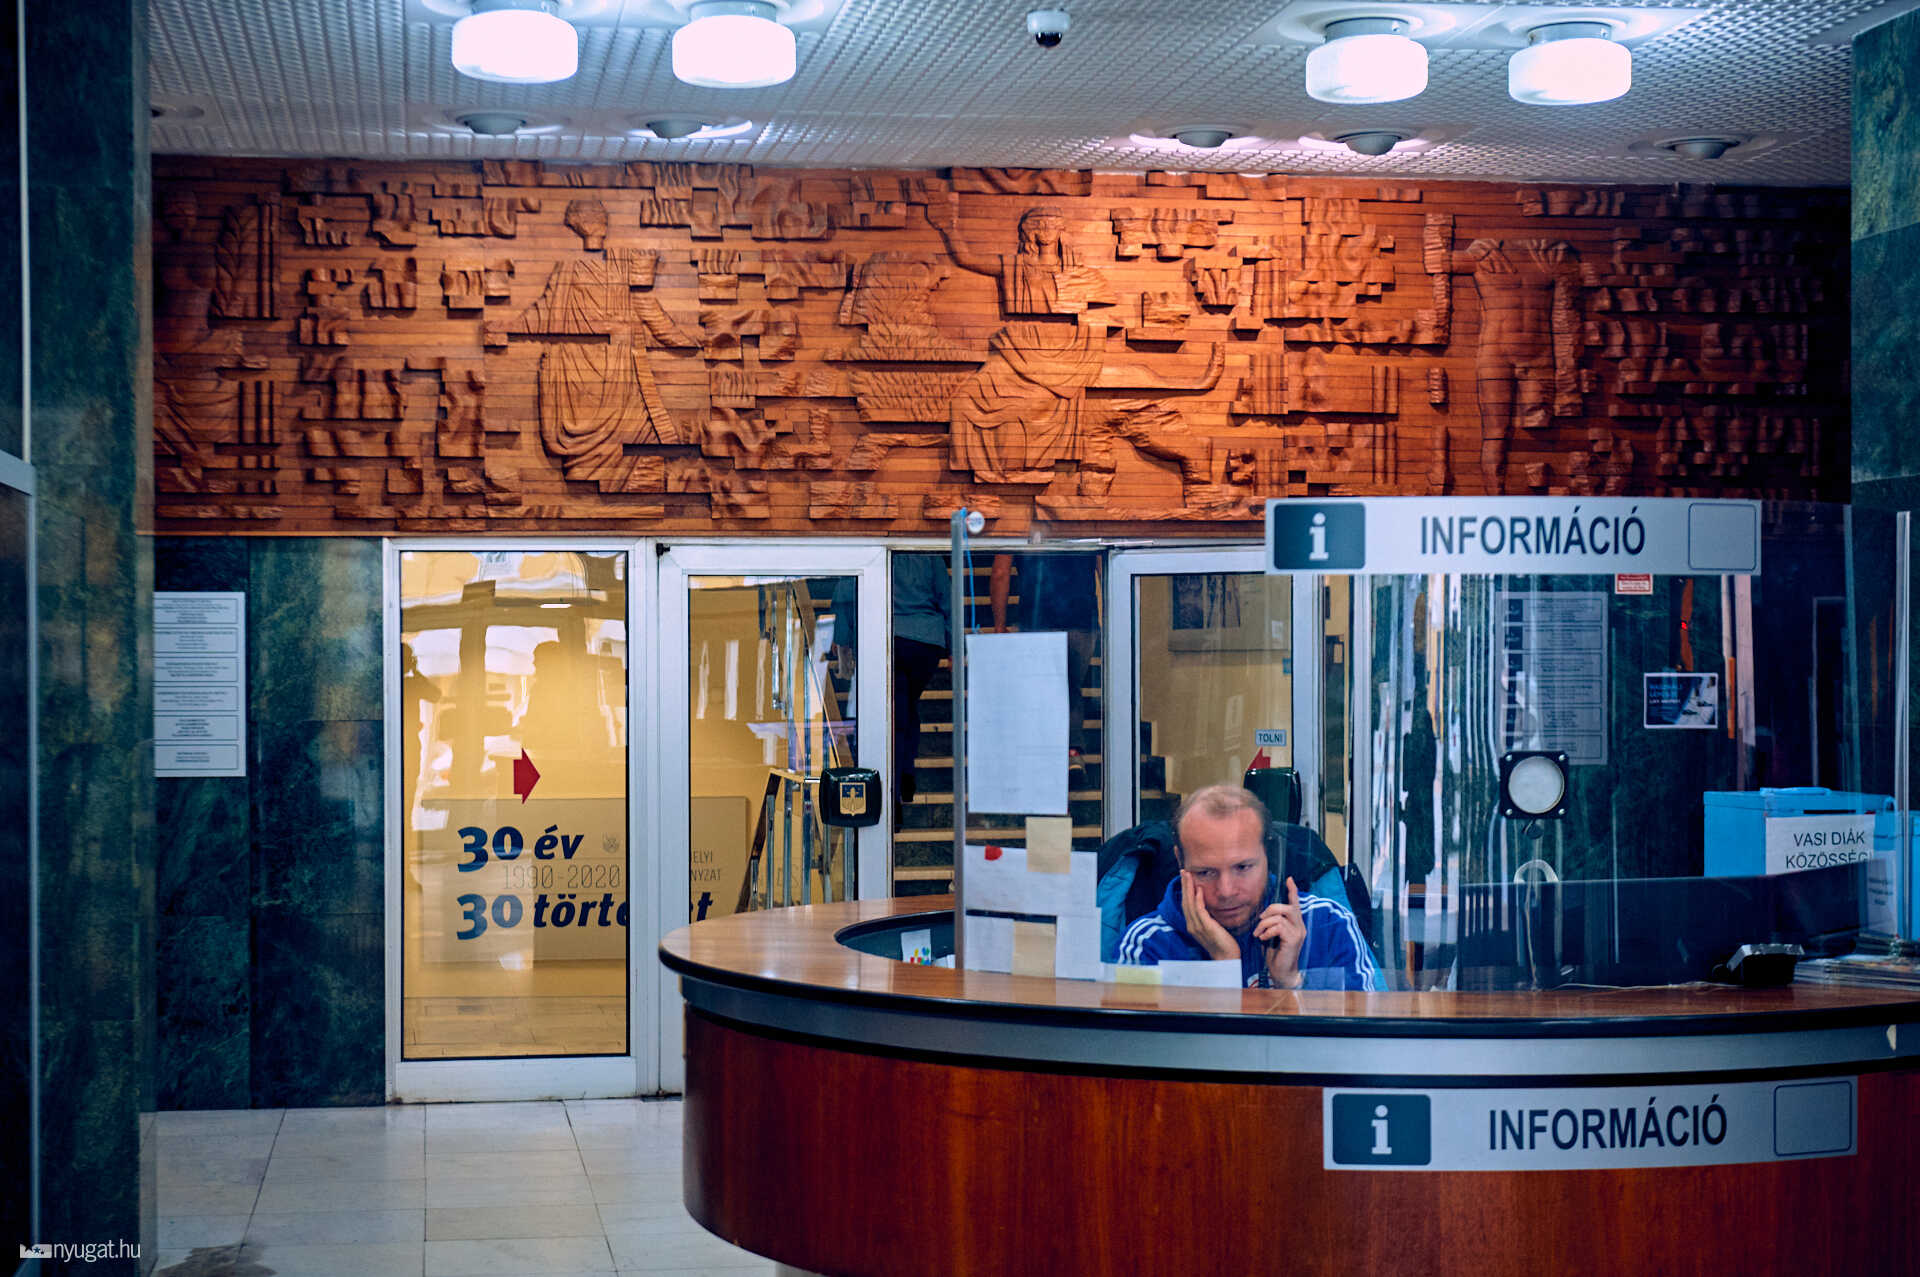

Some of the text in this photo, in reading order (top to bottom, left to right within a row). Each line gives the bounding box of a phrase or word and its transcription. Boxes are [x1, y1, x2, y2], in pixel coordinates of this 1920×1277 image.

[1420, 505, 1646, 556] INFORMÁCIÓ
[1258, 733, 1283, 743] TOLNI
[457, 824, 585, 873] 30 év
[1793, 827, 1866, 847] VASI DIÁK
[456, 893, 523, 940] 30
[1488, 1095, 1728, 1151] INFORMÁCIÓ
